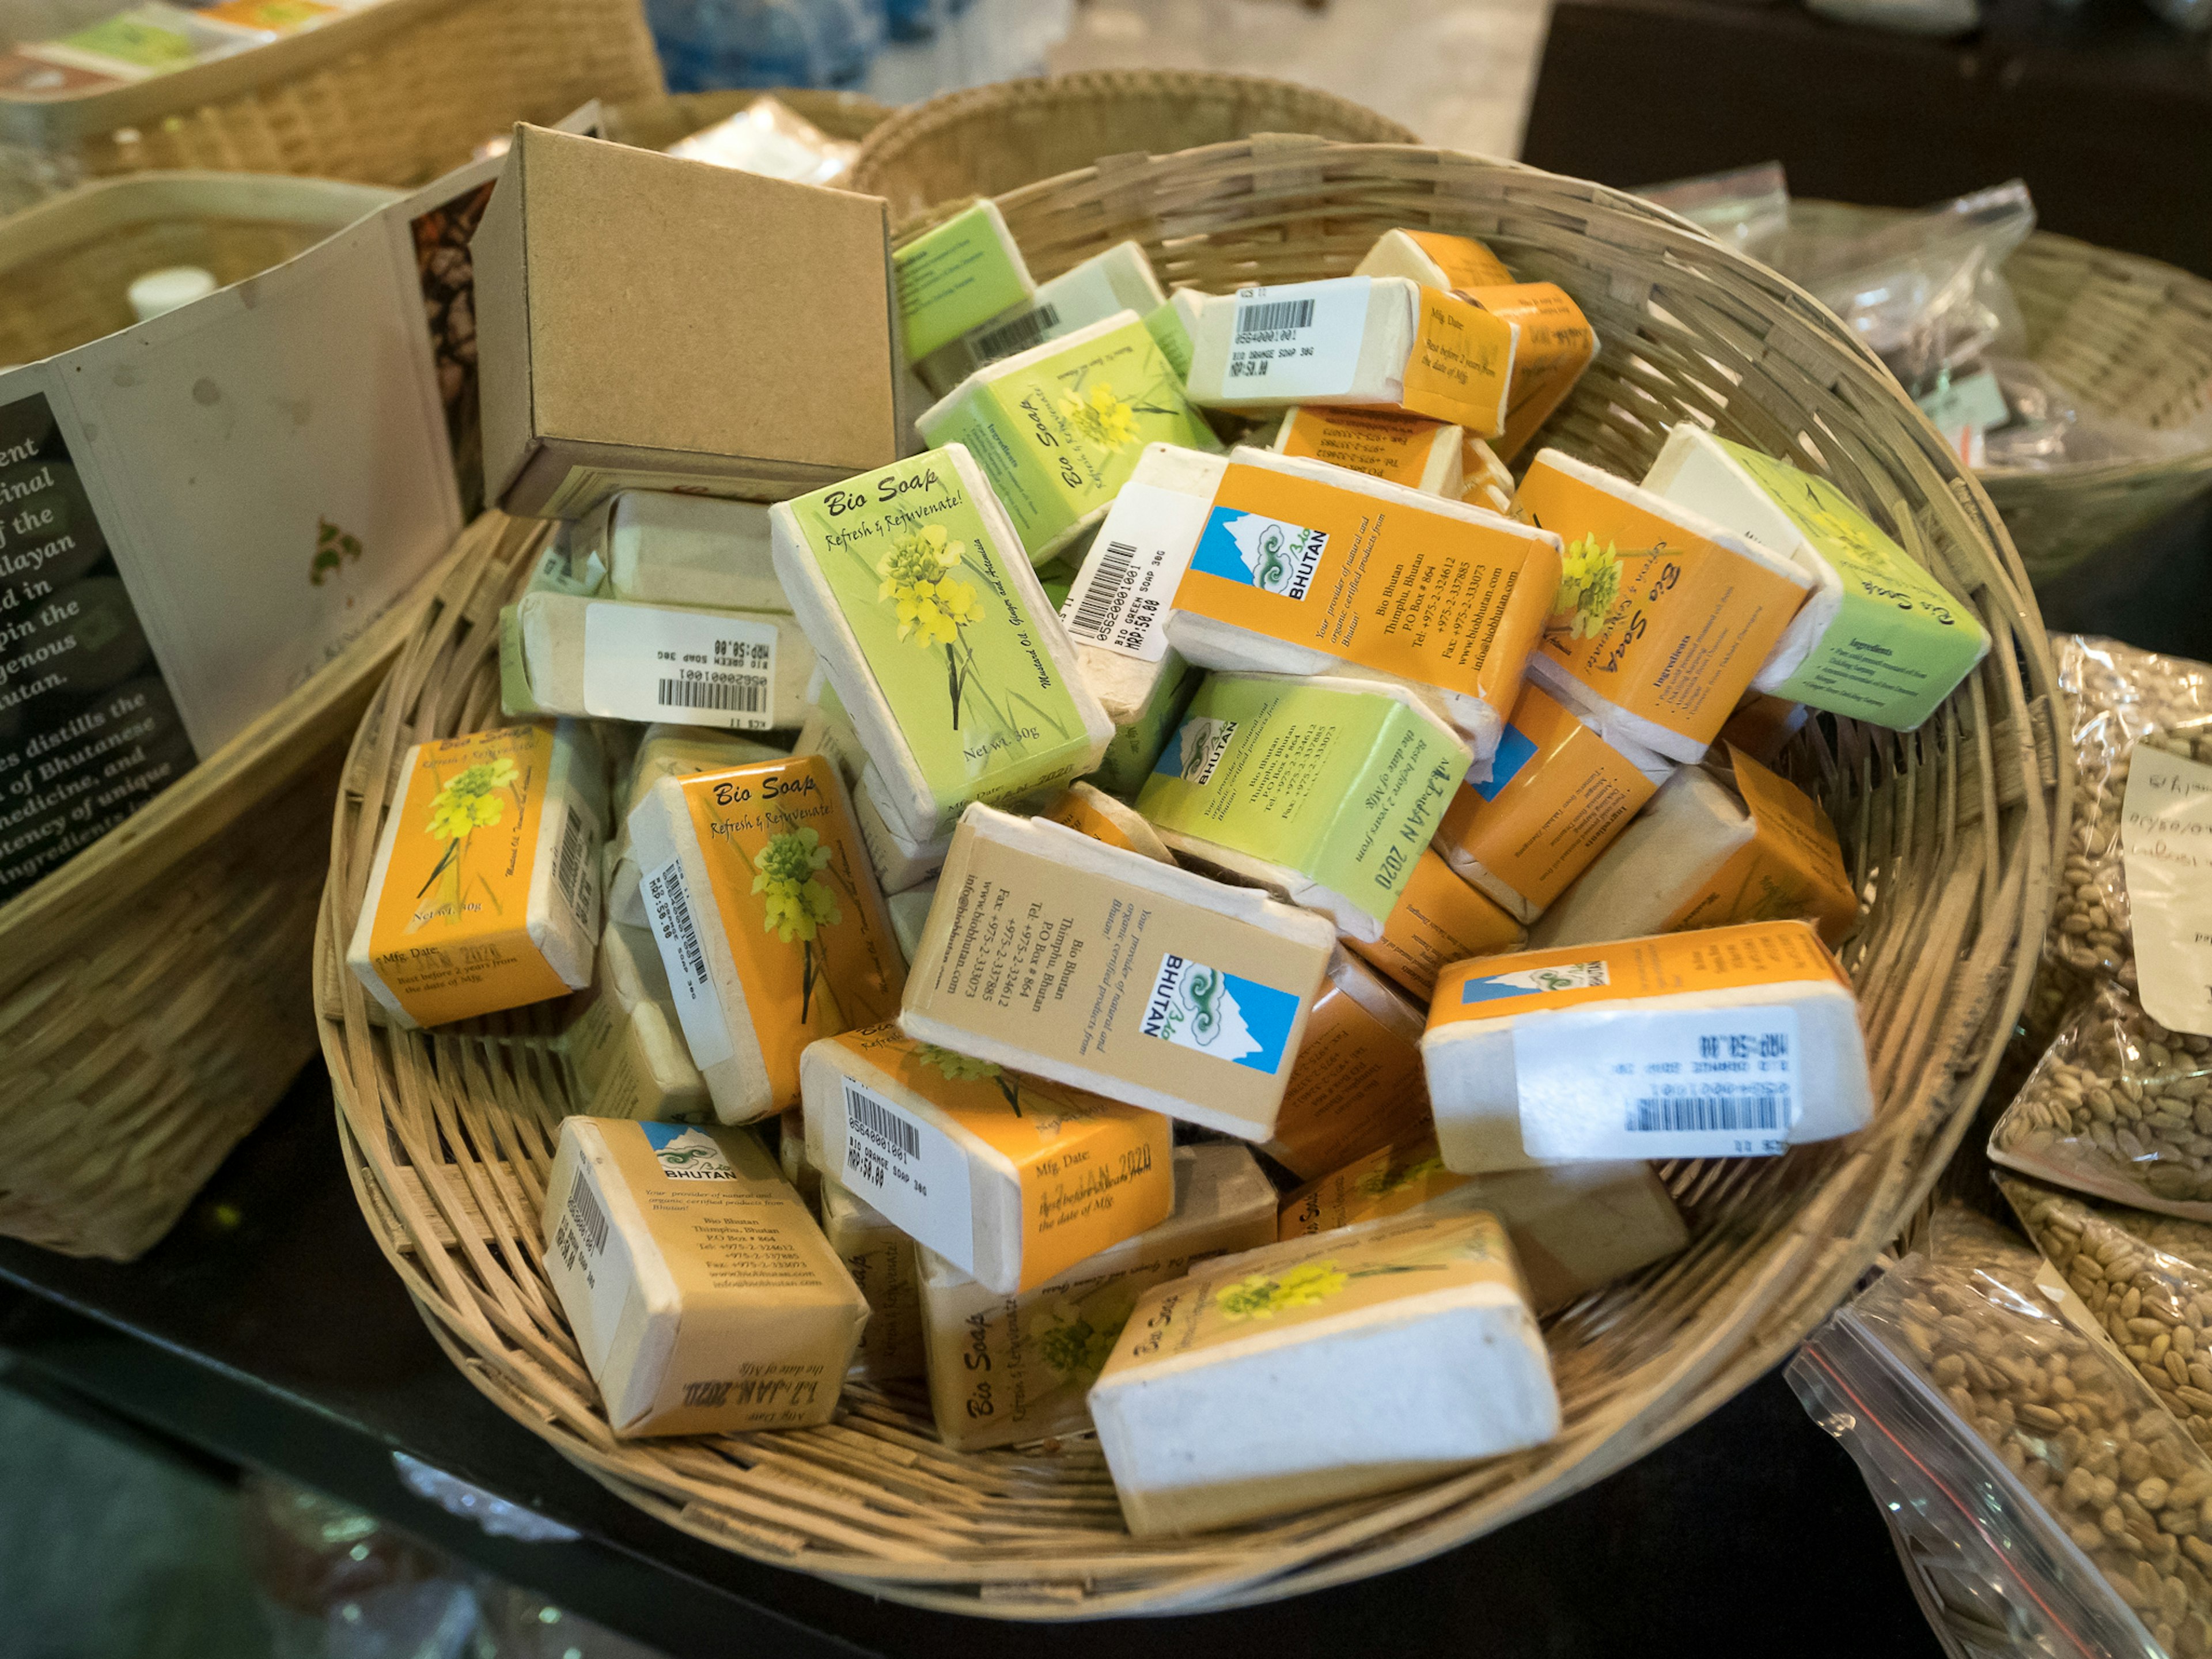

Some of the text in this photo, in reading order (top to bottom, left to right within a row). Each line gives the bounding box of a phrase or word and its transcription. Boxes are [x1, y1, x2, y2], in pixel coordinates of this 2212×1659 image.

[986, 423, 1018, 468] Ingredients
[1020, 393, 1083, 490] Bio Soap
[824, 468, 940, 517] Bio Soap
[825, 521, 873, 551] Refresh
[885, 490, 964, 528] Rejuvenate!
[974, 538, 999, 579] Artemisia
[1288, 529, 1327, 601] BHUTAN
[1289, 528, 1311, 561] Bio
[990, 580, 1007, 596] and
[1096, 565, 1141, 642] 05620001001
[1113, 551, 1166, 646] BIO GREEN SOAP 30G
[1315, 515, 1370, 639] Your provider of natural and
[1331, 513, 1386, 644] organic certified products from
[1374, 563, 1404, 617] Bio Bhutan
[1383, 553, 1425, 635] Thimphu, Bhutan
[1402, 613, 1416, 632] P.O
[1409, 593, 1426, 612] Box
[1422, 565, 1437, 584] 864
[1411, 556, 1456, 648] Tel: +975-2-324612
[1437, 561, 1471, 634] +975-2-337885
[40, 600, 79, 627] the
[1003, 599, 1025, 626] Ginger
[1126, 599, 1160, 651] MRP:50.00
[1340, 611, 1360, 648] Bhutan!
[1441, 564, 1486, 659] Fax: +975-2-333073
[1457, 567, 1503, 665] www.biobhutan.com
[1473, 571, 1519, 672] info@biobhutan.com
[1594, 562, 1681, 673] Bio Soap
[683, 654, 707, 664] SOAP
[714, 639, 770, 660] MRP:50.00
[714, 657, 744, 667] GREEN
[1025, 649, 1052, 690] Mustard
[1652, 634, 1691, 688] Ingredients
[10, 717, 156, 796] of Bhutanese
[26, 712, 106, 759] distills
[110, 694, 146, 718] the
[963, 744, 989, 762] Net
[990, 737, 1012, 751] wt.
[1198, 720, 1238, 786] BHUTAN
[1400, 729, 1415, 749] the
[1248, 736, 1281, 788] Bio Bhutan
[1249, 724, 1298, 804] Thimphu, Bhutan
[1271, 761, 1287, 781] Box
[1287, 734, 1302, 752] 864
[1276, 723, 1318, 793] +975-2-324612
[1285, 725, 1326, 796] +975-2-337885
[1294, 725, 1337, 796] +975-2-333073
[1379, 772, 1389, 788] of
[1387, 747, 1405, 774] date
[71, 797, 93, 820] of
[98, 762, 171, 806] unique
[710, 812, 753, 839] Refresh
[764, 802, 834, 835] Rejuvenate!
[713, 775, 816, 806] Bio Soap
[1354, 738, 1428, 863] Best before 2 years from
[649, 879, 673, 939] MRP:50.00
[946, 881, 993, 995] www.biobhutan.com
[1103, 898, 1123, 941] Bhutan!
[965, 888, 1010, 998] Fax: +975-2-333073
[982, 918, 1016, 1002] +975-2-337885
[997, 902, 1043, 1007] Tel: +975-2-324612
[1018, 921, 1054, 998] P.O Box # 864
[1032, 918, 1074, 1013] Thimphu, Bhutan
[1054, 938, 1084, 1001] Bio Bhutan
[1078, 903, 1135, 1056] organic certified products from
[1096, 908, 1152, 1054] Your provider of natural and
[1142, 955, 1183, 1037] BHUTAN
[1160, 1006, 1184, 1040] Bio
[847, 1152, 884, 1190] MRP:50.00
[849, 1119, 908, 1165] 05640001001
[864, 1146, 889, 1171] ORANGE
[892, 1165, 910, 1183] SOAP
[1062, 1151, 1090, 1168] Date:
[664, 1170, 738, 1180] BHUTAN
[723, 1217, 760, 1225] Bhutan
[964, 1311, 995, 1420] Bio Soap
